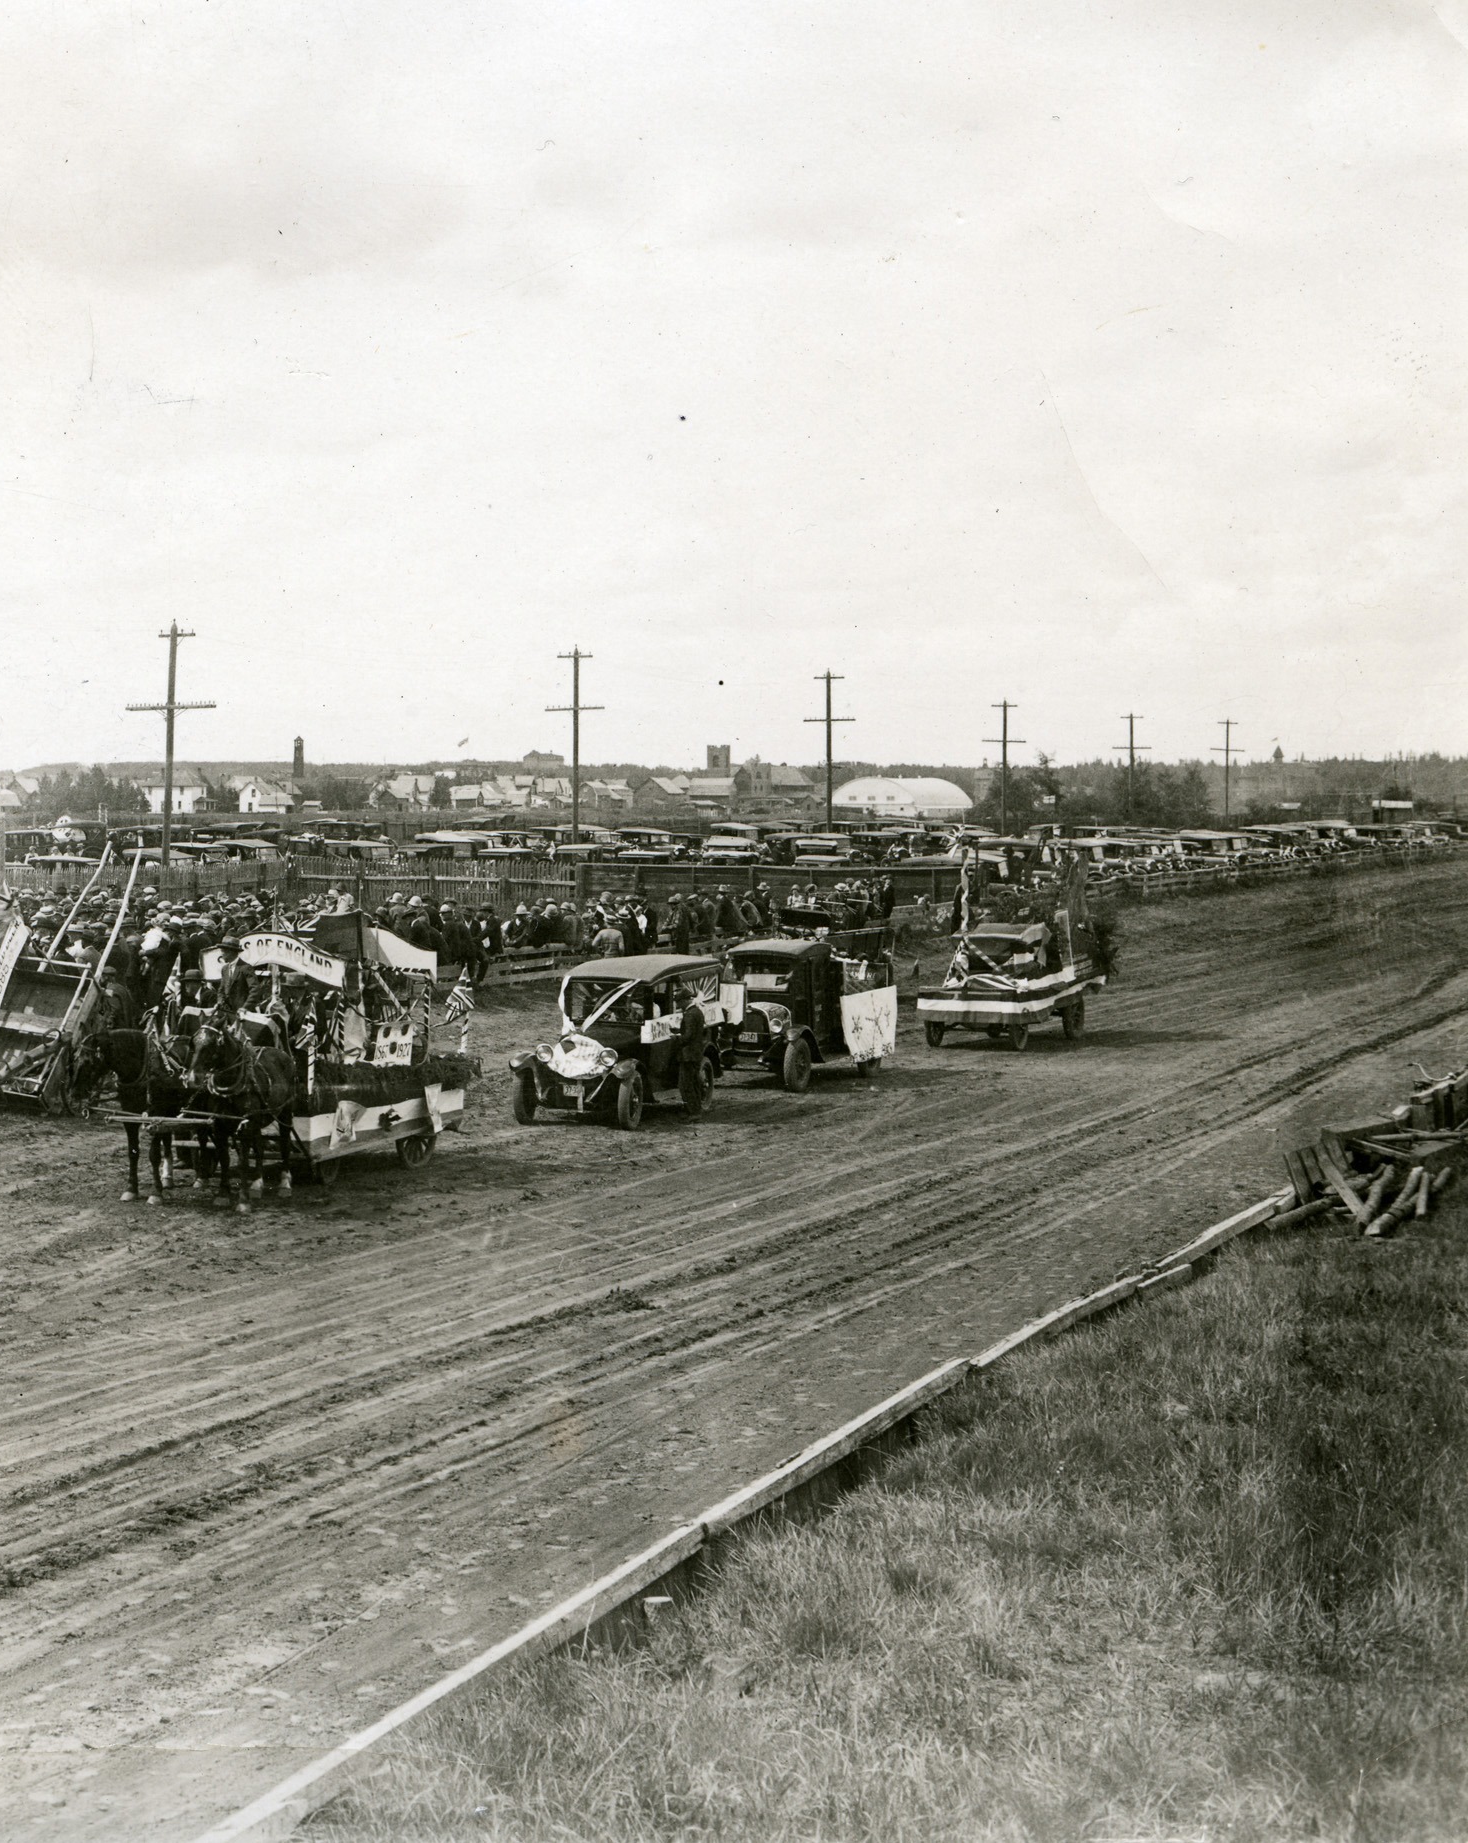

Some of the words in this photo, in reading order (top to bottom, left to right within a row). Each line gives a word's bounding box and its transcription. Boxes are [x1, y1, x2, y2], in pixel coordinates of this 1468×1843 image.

[256, 939, 272, 957] OF
[277, 940, 332, 977] ENGLAND
[397, 1042, 411, 1058] 1927
